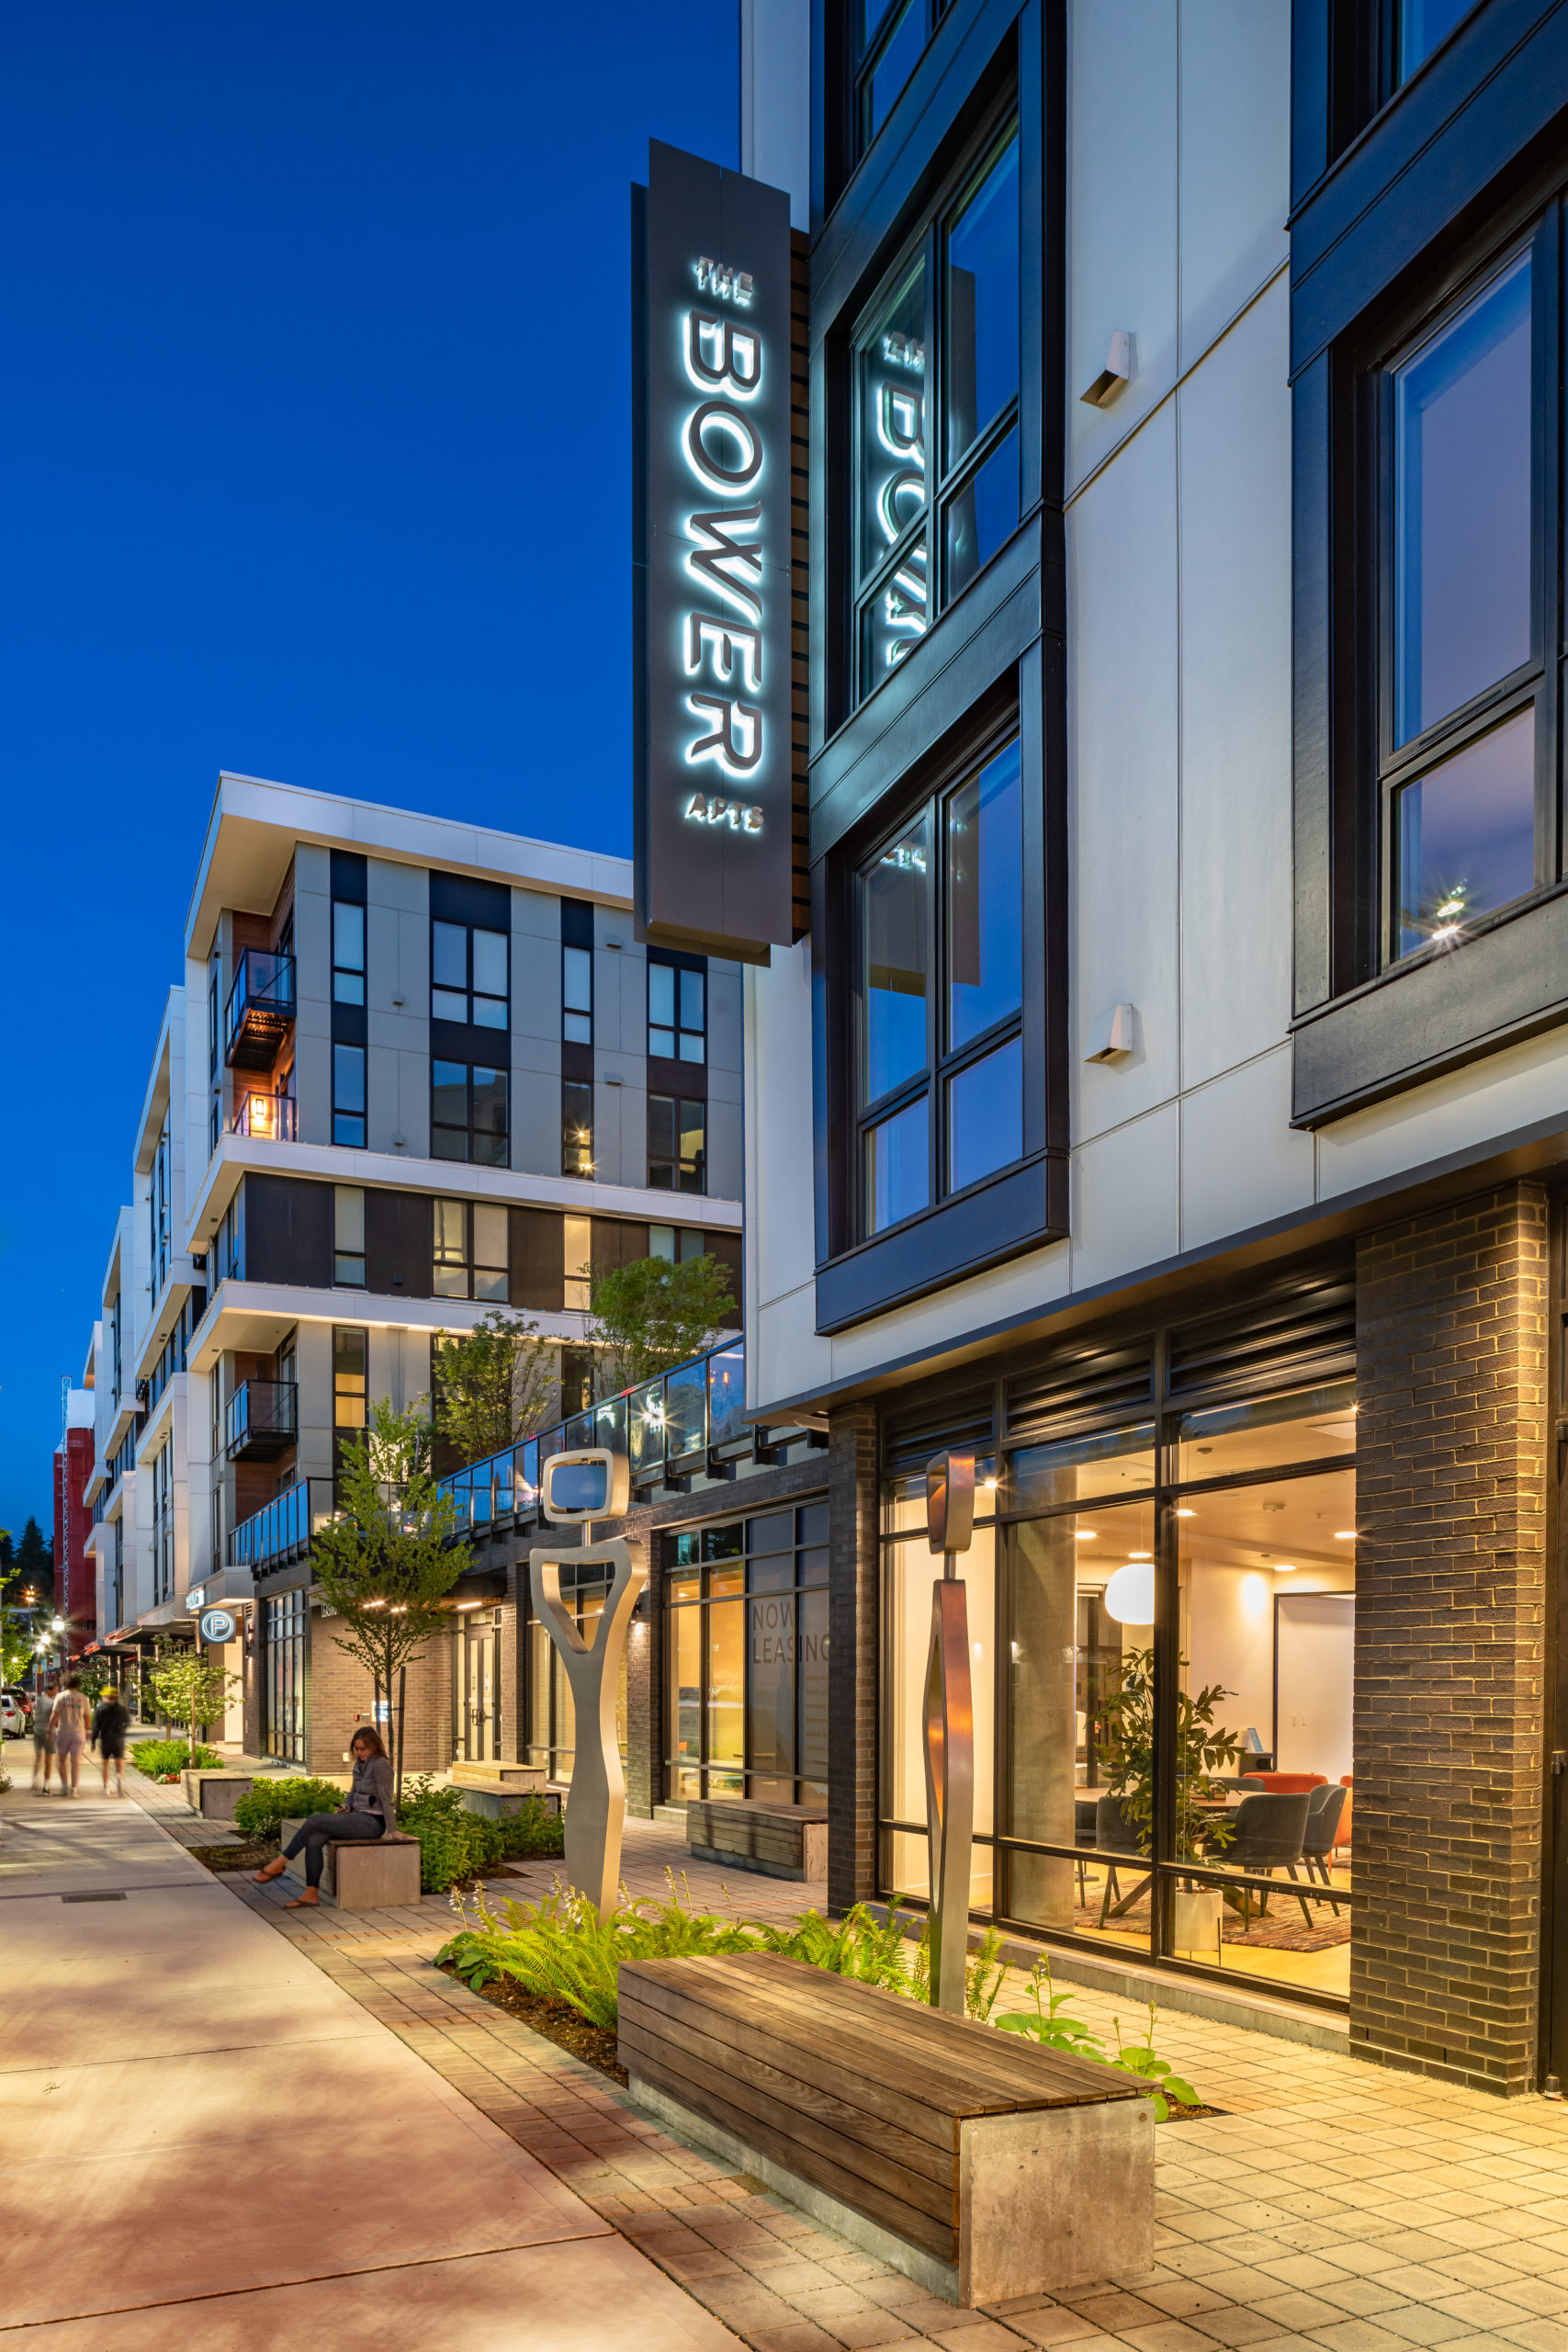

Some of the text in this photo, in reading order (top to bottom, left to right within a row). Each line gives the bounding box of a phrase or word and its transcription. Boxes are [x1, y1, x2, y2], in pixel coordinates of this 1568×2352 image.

[694, 256, 753, 305] THE
[683, 309, 762, 777] BOWER
[685, 792, 764, 832] APTS
[752, 1601, 795, 1632] NOW
